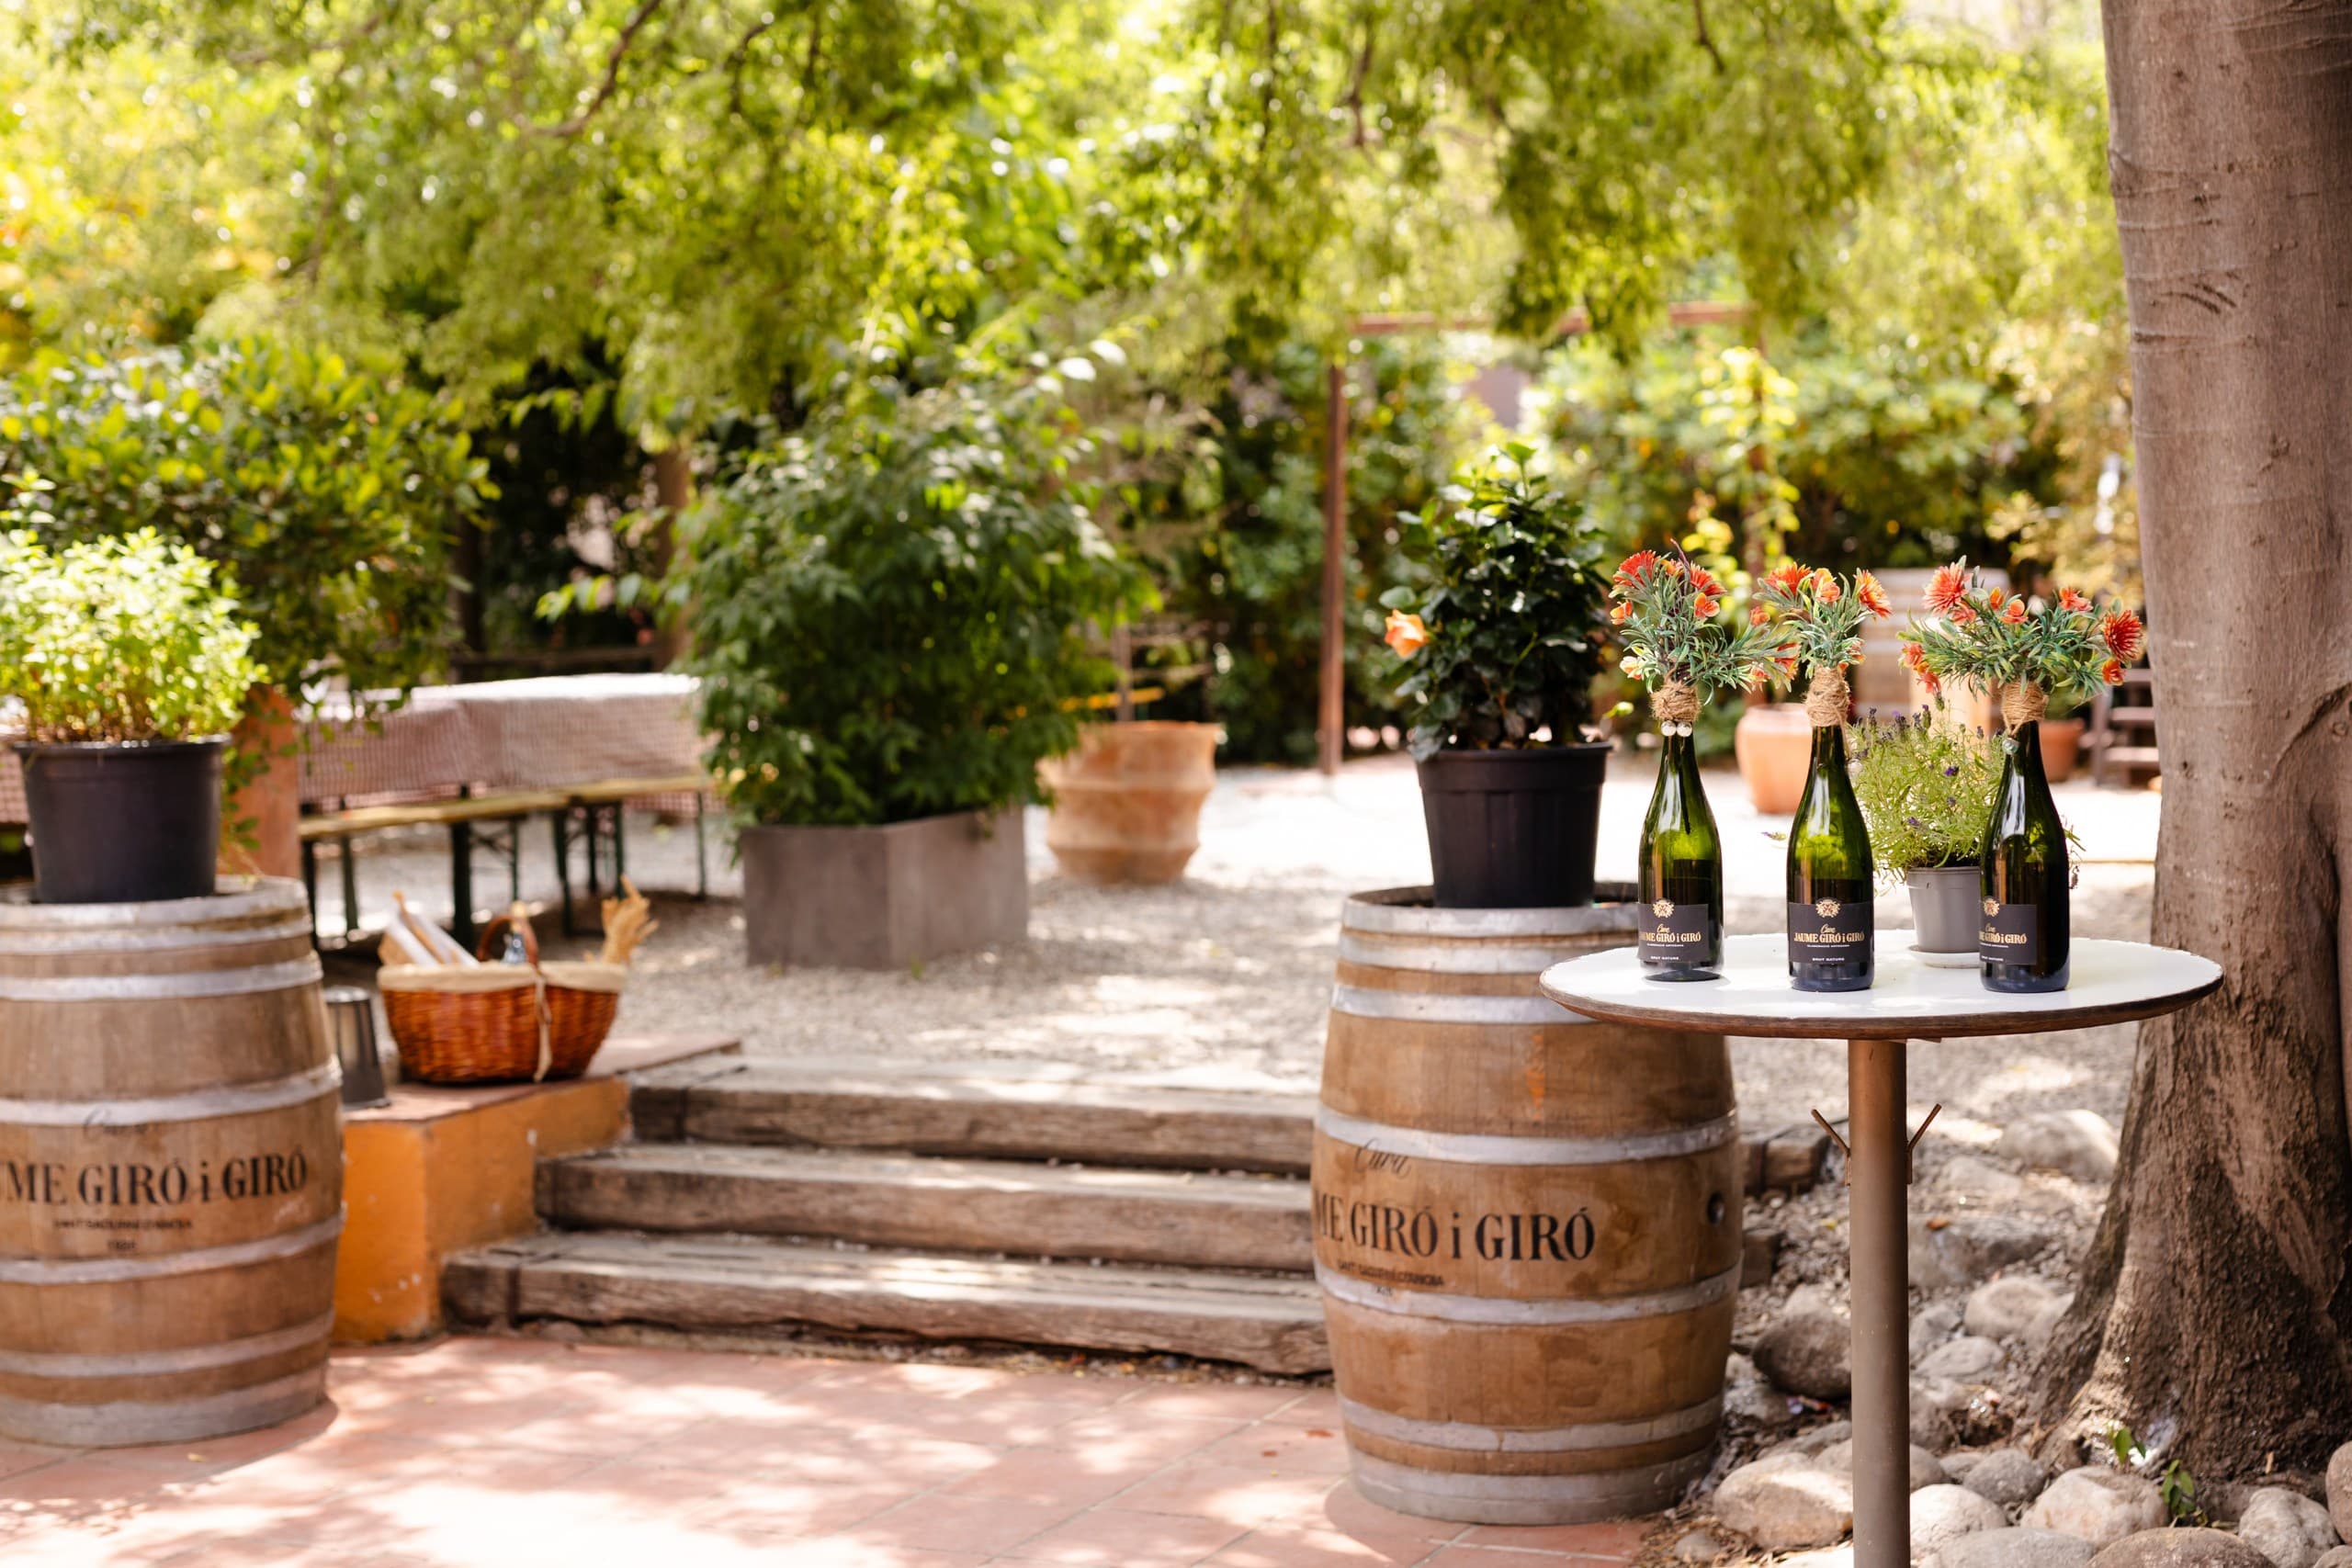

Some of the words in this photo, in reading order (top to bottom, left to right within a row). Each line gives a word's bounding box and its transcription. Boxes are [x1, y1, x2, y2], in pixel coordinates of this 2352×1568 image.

[1656, 931, 1675, 942] GIRÓ
[1680, 931, 1701, 942] GIRÓ
[1794, 932, 1818, 942] JAUME
[1819, 932, 1840, 943] GIRÓ
[1846, 931, 1864, 942] GIRÓ
[2005, 933, 2027, 943] GIRÓ
[78, 1156, 189, 1206] GIRÓ
[200, 1161, 210, 1202] i
[221, 1146, 308, 1200] GIRÓ
[1351, 1201, 1439, 1258] GIRÓ
[1452, 1212, 1462, 1259] i
[1475, 1207, 1596, 1261] GIRÓ
